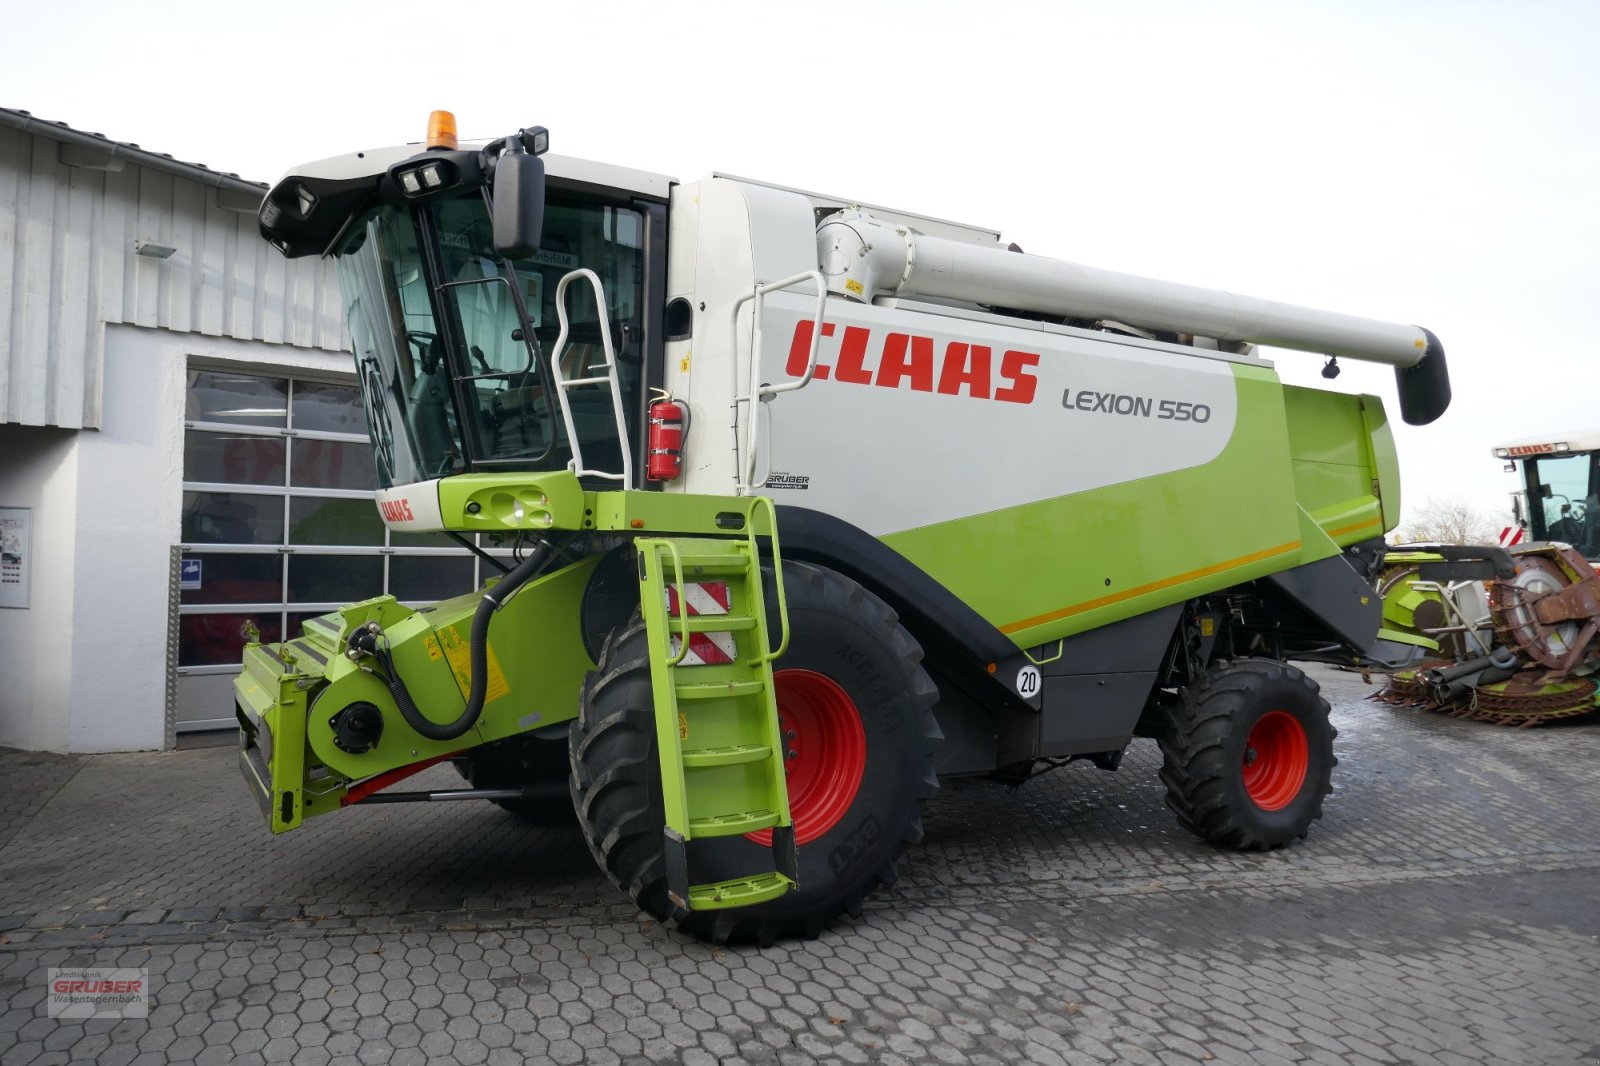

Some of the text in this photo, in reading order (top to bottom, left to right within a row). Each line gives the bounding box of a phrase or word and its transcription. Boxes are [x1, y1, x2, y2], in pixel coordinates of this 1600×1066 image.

[785, 319, 1040, 405] CLAAS
[1061, 389, 1210, 424] LEXION 550
[1509, 443, 1553, 455] CLAAS
[1021, 671, 1036, 693] 20
